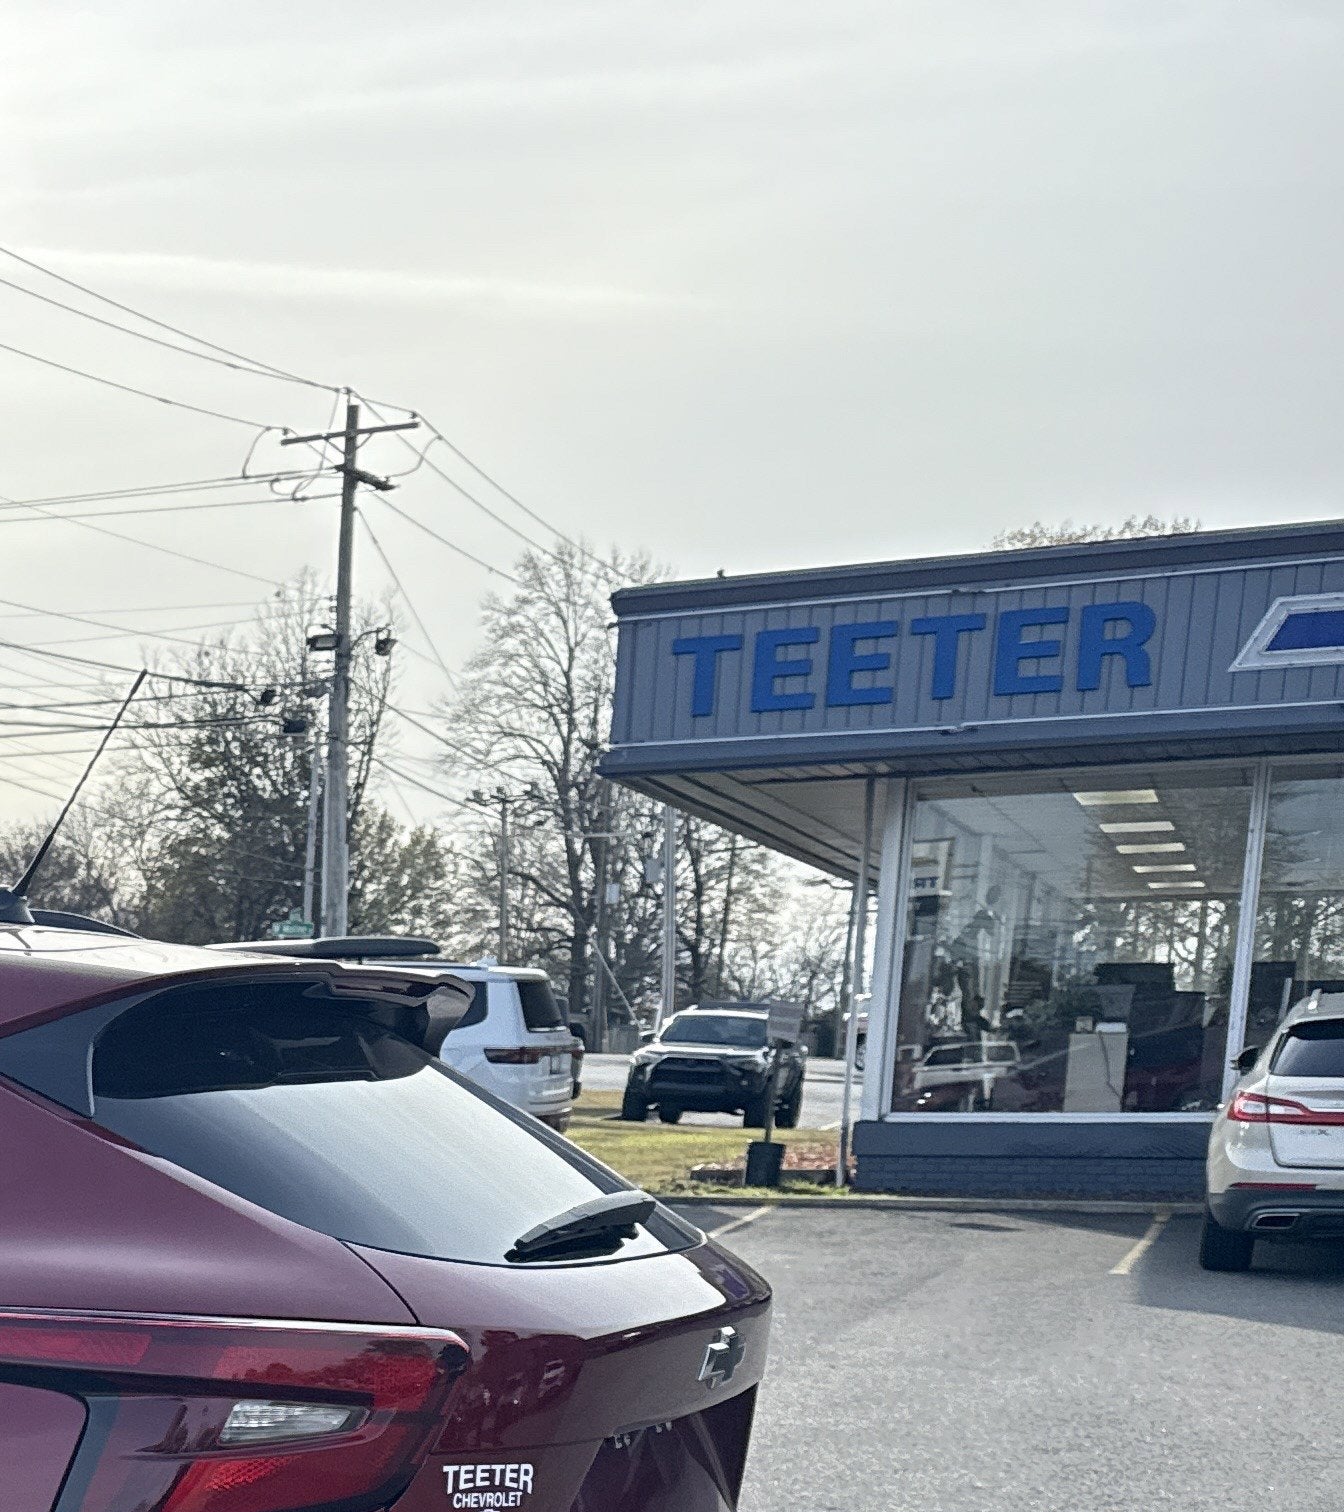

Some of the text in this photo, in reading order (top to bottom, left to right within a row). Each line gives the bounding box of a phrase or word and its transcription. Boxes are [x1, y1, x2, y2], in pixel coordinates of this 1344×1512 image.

[671, 600, 1157, 718] TEETER
[442, 1463, 534, 1495] TEETER
[452, 1491, 523, 1508] CHEVROLET
